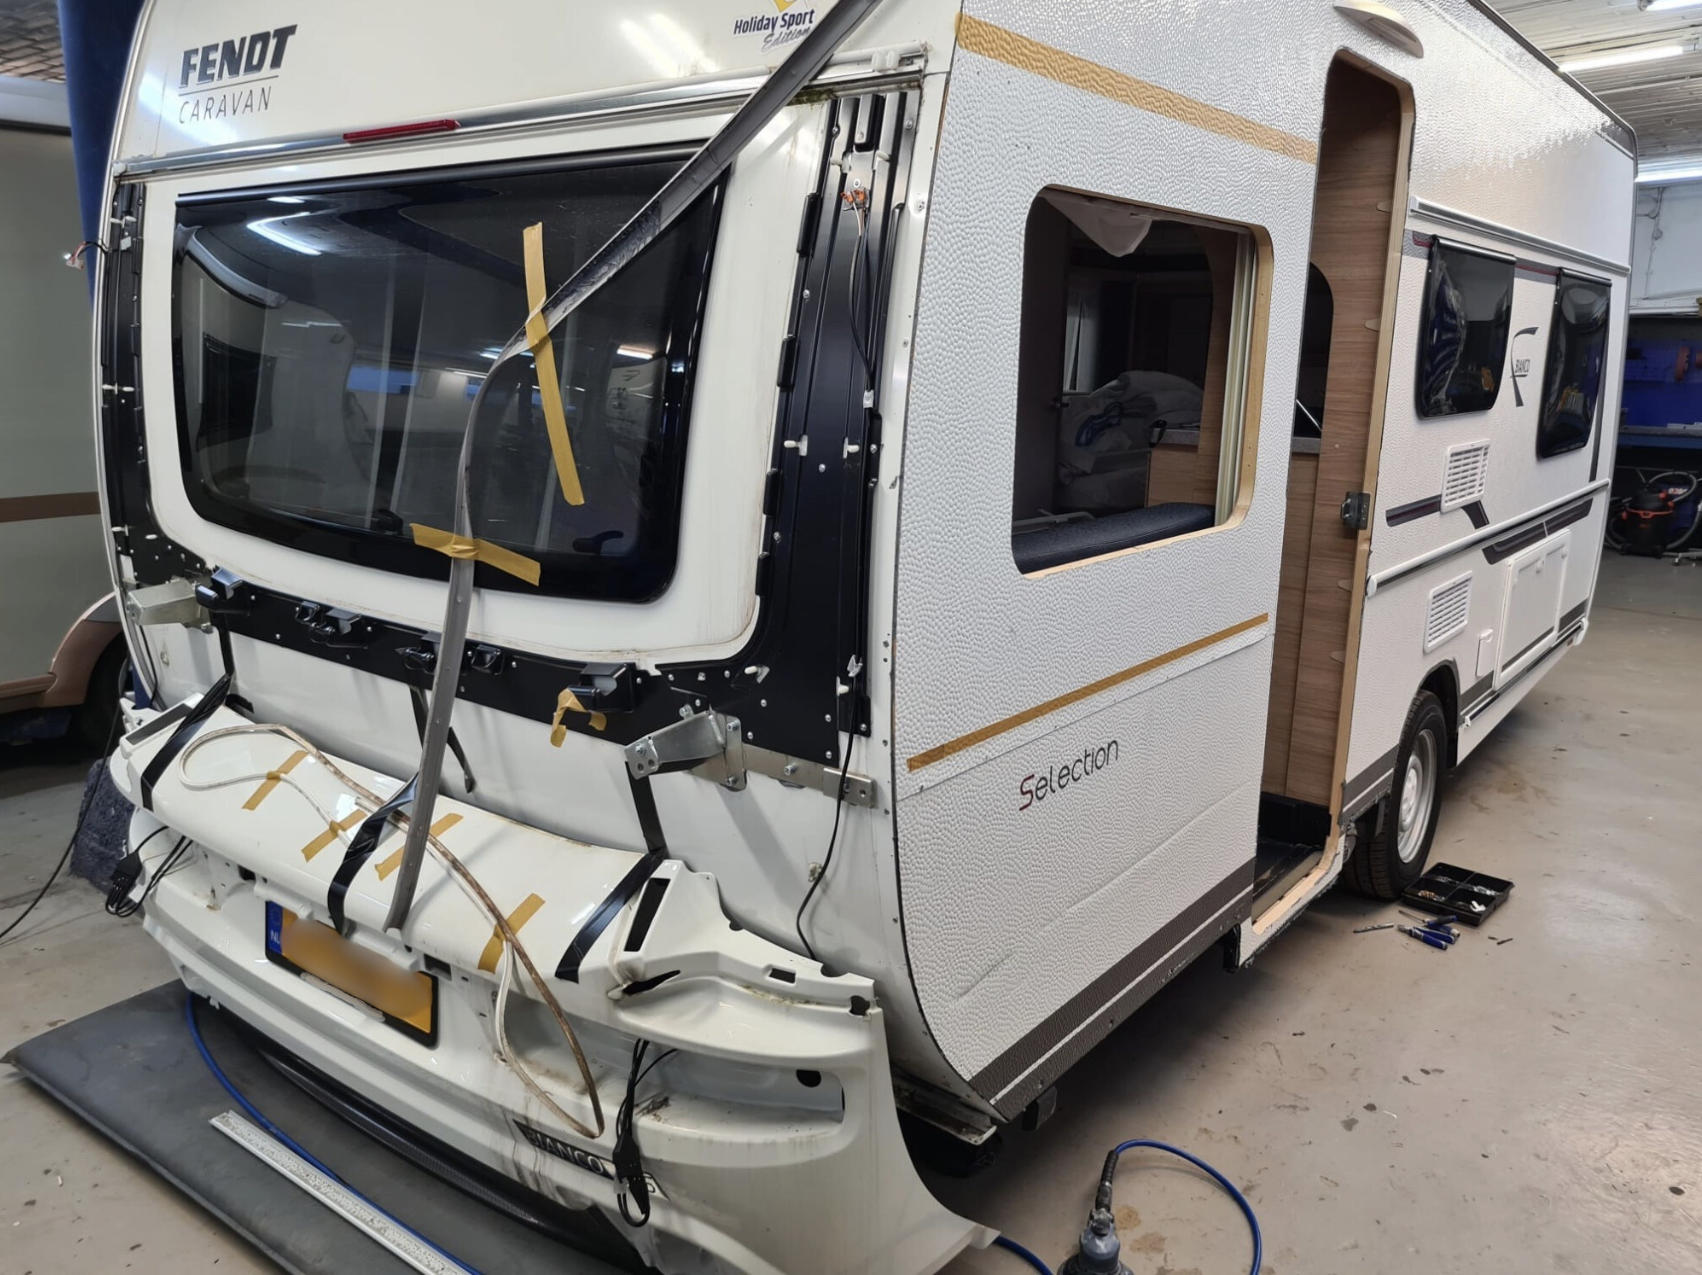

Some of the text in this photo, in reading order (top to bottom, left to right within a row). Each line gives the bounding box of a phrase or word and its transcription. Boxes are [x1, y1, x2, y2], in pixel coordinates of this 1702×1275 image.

[733, 9, 815, 35] Holiday Sport
[761, 27, 811, 53] Edition
[179, 24, 298, 88] FENDT
[179, 86, 271, 124] CARAVAN
[1019, 740, 1119, 811] Selection
[525, 1130, 604, 1174] BIANCO
